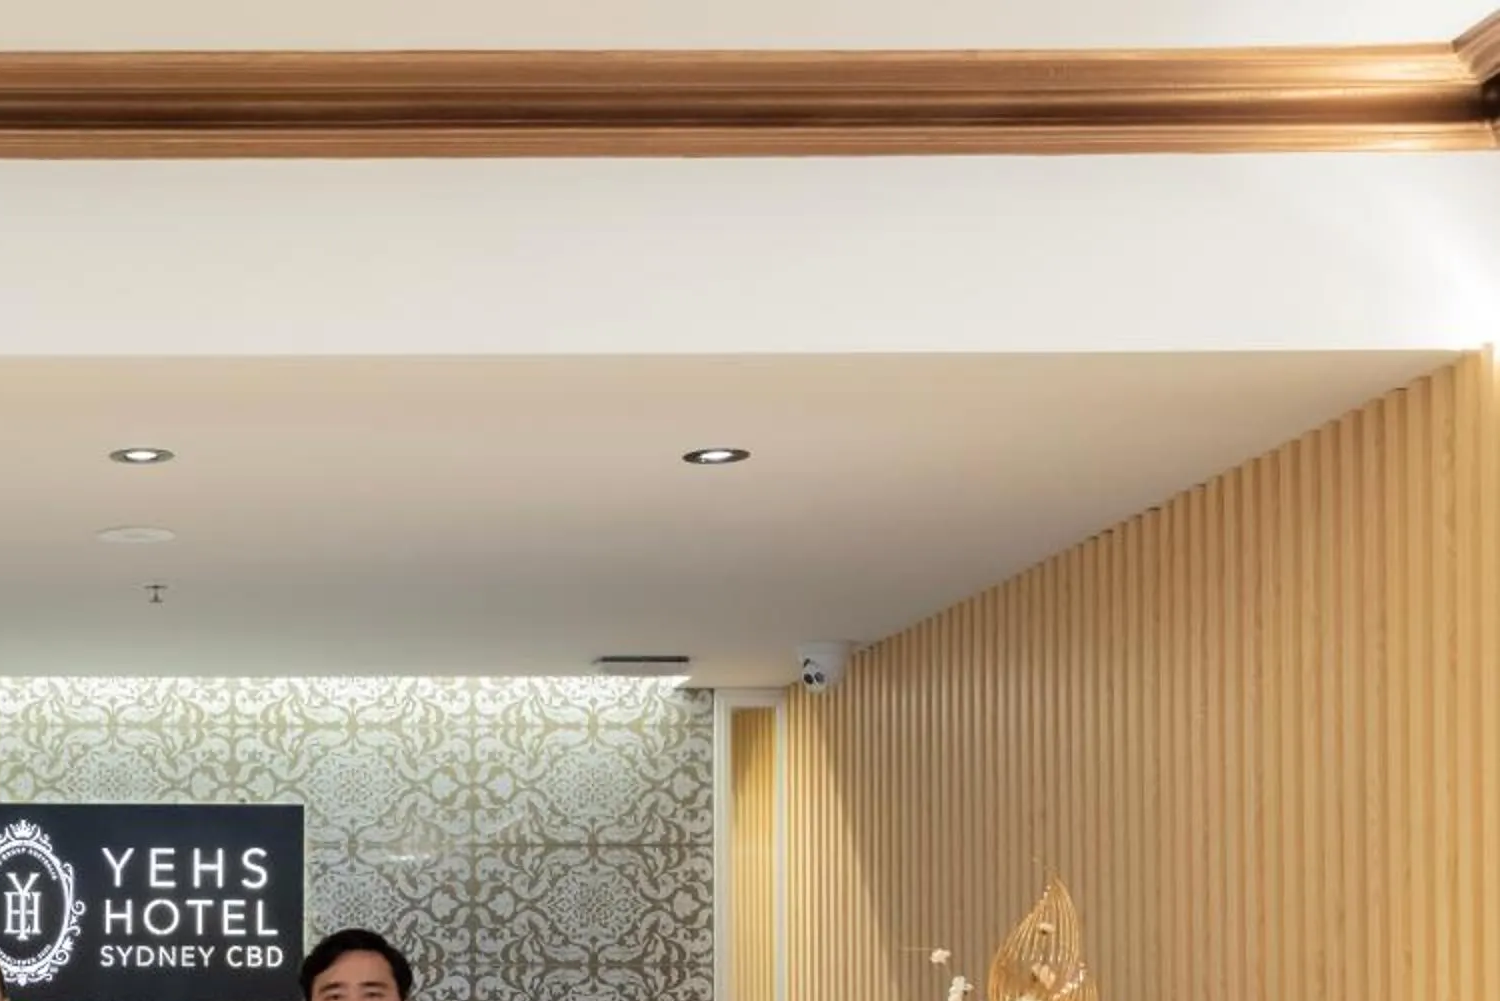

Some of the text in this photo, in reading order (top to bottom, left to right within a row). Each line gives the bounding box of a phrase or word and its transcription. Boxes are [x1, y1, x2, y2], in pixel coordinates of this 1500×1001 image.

[101, 847, 268, 890] YEHS
[105, 898, 278, 936] HOTEL
[100, 945, 284, 968] SYDNEY CBD
